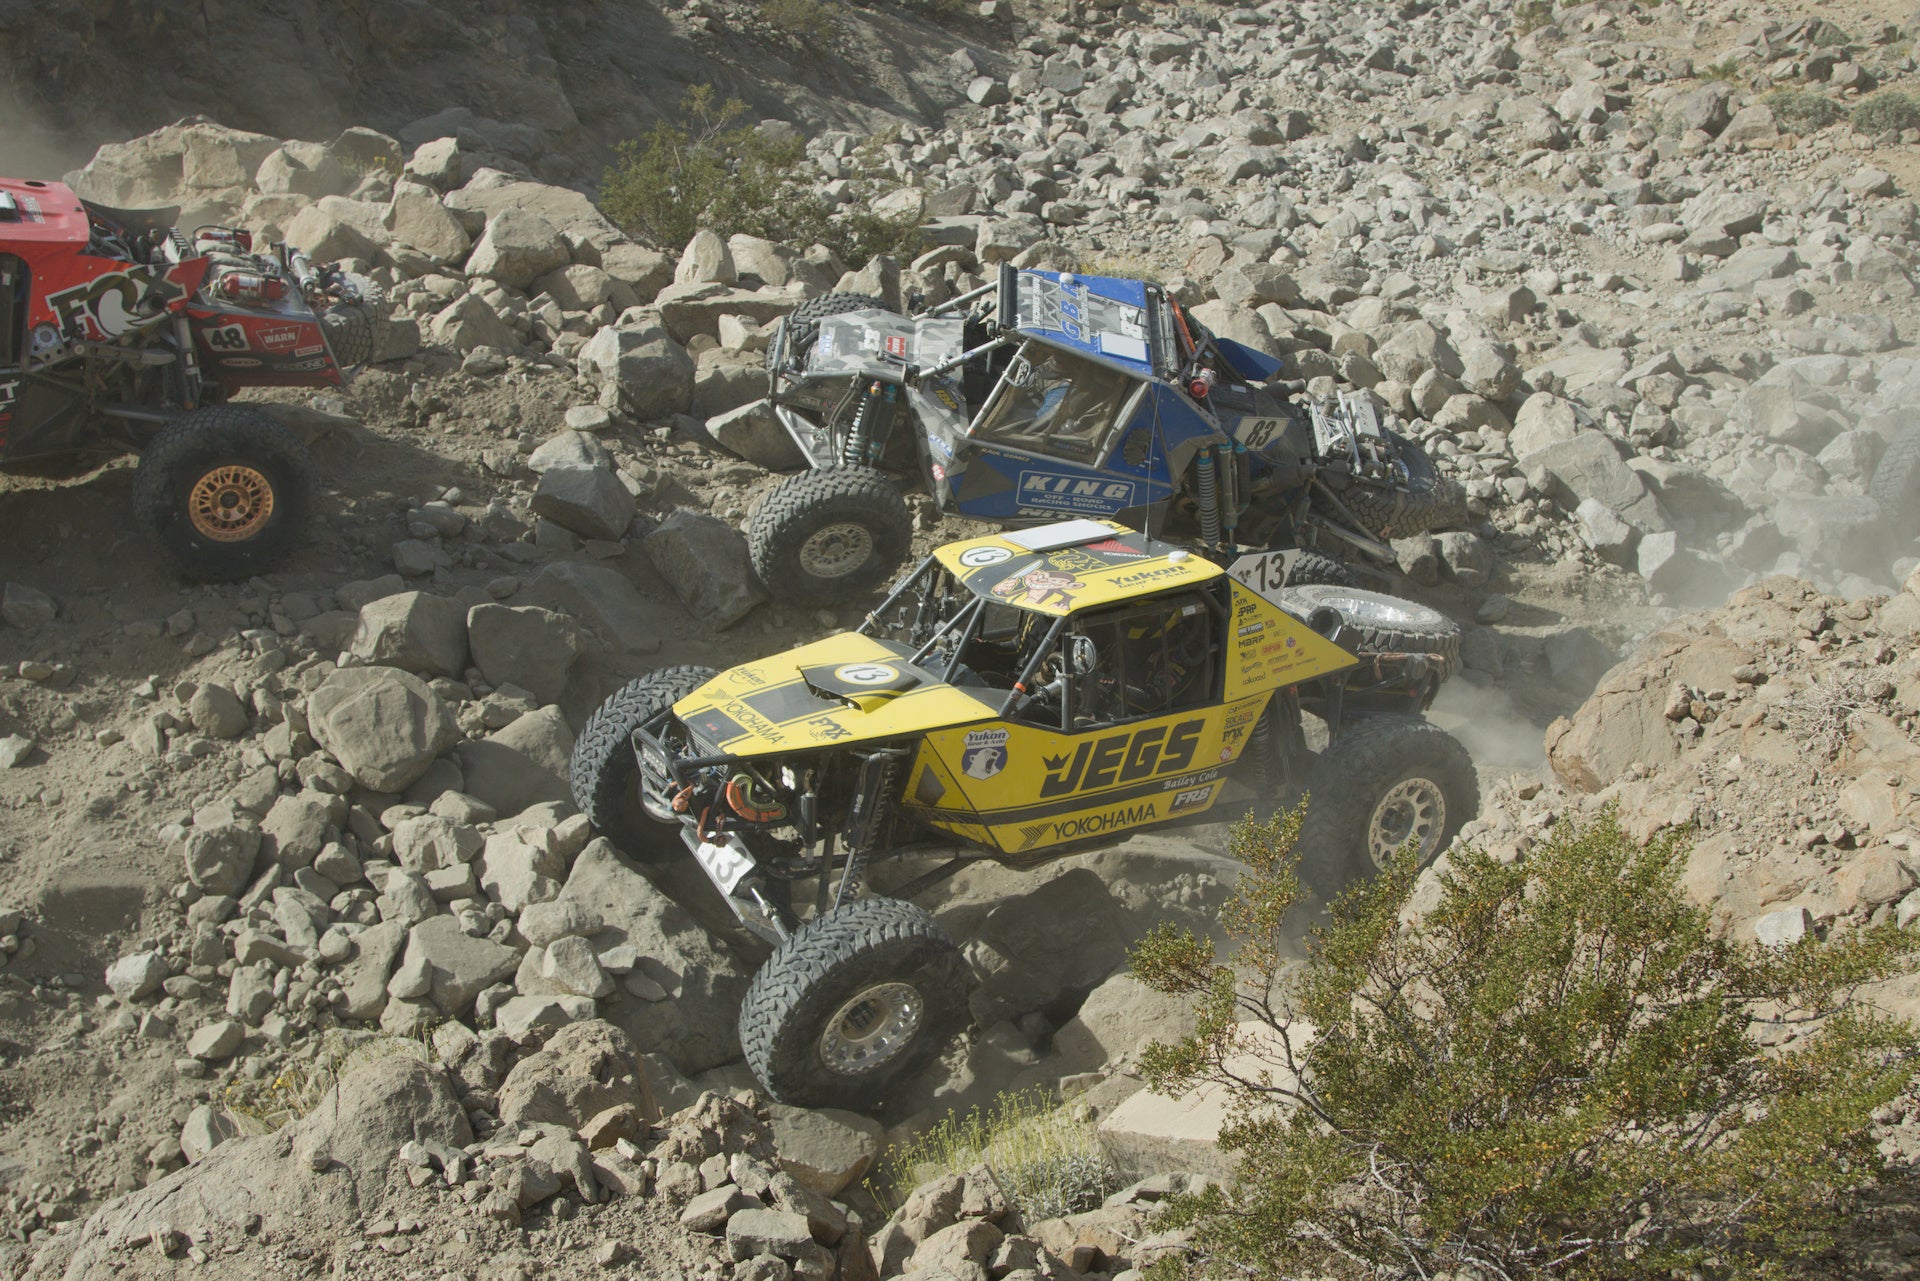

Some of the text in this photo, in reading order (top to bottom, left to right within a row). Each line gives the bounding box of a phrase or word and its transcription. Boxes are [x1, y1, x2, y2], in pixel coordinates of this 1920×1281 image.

[45, 264, 188, 342] FOX
[211, 327, 246, 349] 48
[264, 332, 296, 344] WARN
[864, 329, 881, 351] 83
[1244, 420, 1278, 448] 83
[1023, 475, 1130, 499] KING
[1031, 498, 1112, 511] RACING SHOCKS
[964, 547, 1009, 564] 13
[1103, 551, 1152, 560] YOKOHAMA
[1106, 565, 1186, 585] Yukon
[1254, 552, 1286, 593] 13
[1238, 634, 1265, 648] MBRP
[845, 667, 890, 681] 13
[722, 700, 785, 745] YOKOHAMA
[808, 717, 853, 740] FOX
[968, 732, 1006, 741] Yukon
[1040, 718, 1206, 799] JEGS
[1163, 768, 1218, 790] Bailey Cole
[1053, 803, 1156, 841] YOKOHAMA
